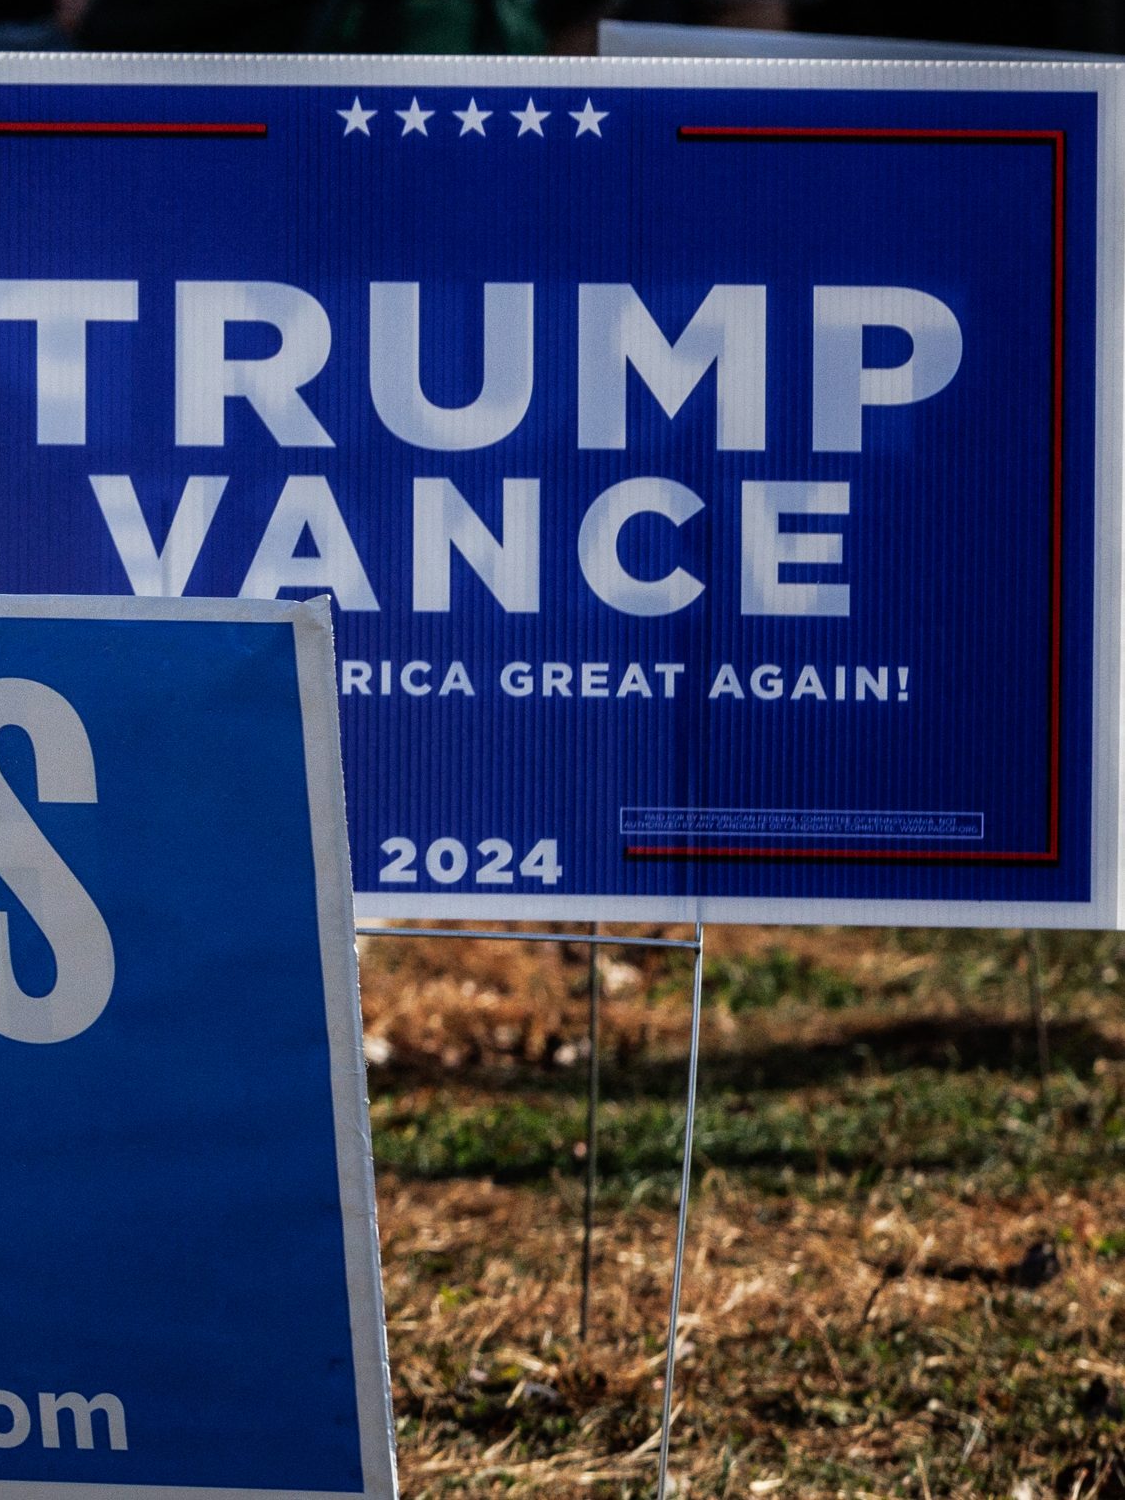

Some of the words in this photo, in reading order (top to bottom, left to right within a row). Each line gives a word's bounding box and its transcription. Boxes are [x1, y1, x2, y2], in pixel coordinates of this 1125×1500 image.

[88, 475, 851, 617] VANCE
[341, 659, 476, 697] RICA
[499, 661, 685, 698] GREAT
[708, 663, 909, 702] AGAIN!
[645, 812, 665, 821] PAID
[667, 812, 684, 821] FOR
[686, 813, 697, 821] BY
[801, 815, 850, 824] COMMITTEE
[854, 816, 866, 825] OF
[683, 821, 694, 829] BY
[696, 821, 715, 829] ANY
[717, 821, 766, 830] CANDIDATE
[379, 836, 563, 885] 2024
